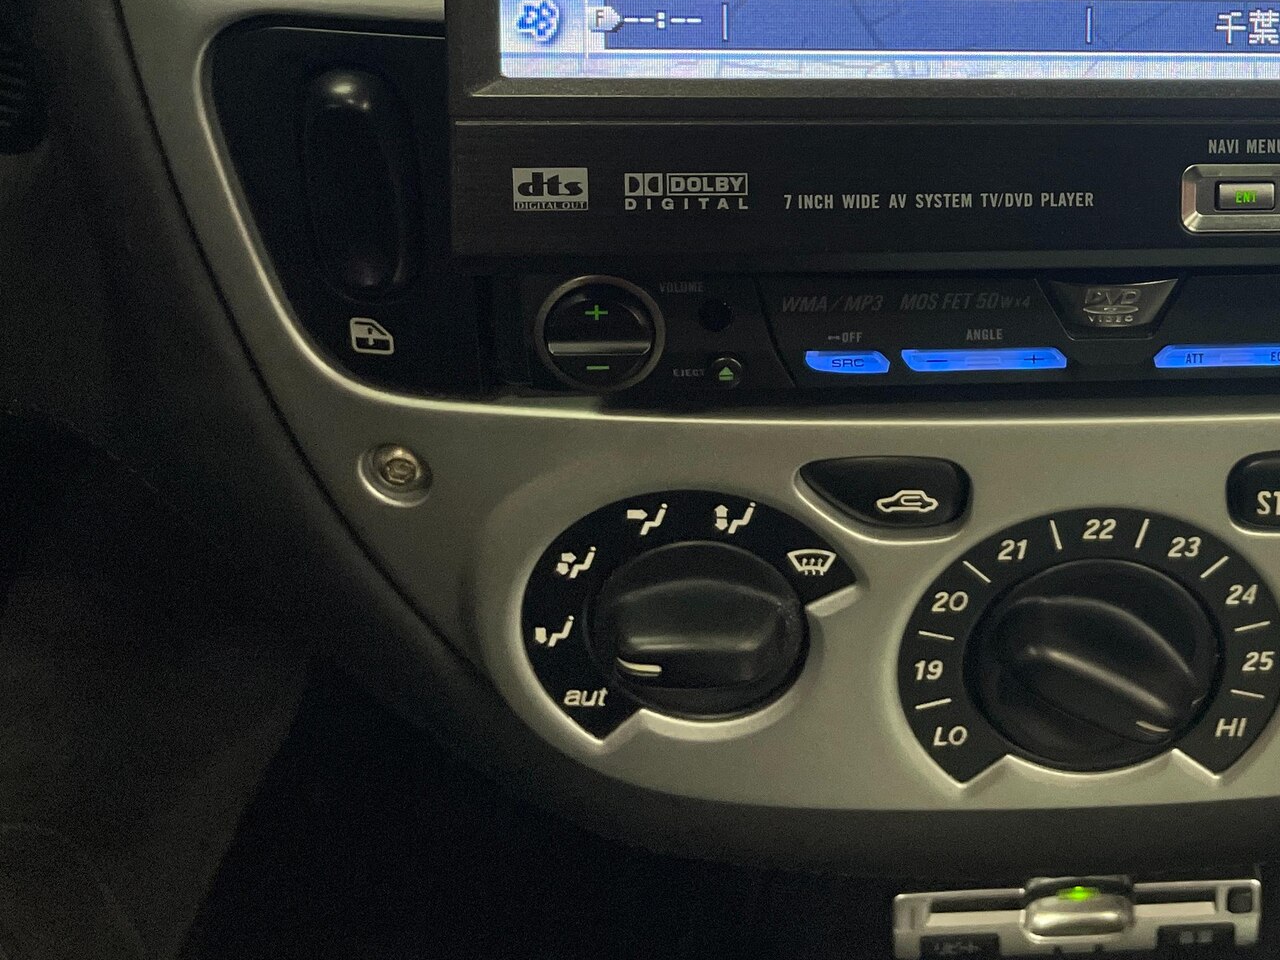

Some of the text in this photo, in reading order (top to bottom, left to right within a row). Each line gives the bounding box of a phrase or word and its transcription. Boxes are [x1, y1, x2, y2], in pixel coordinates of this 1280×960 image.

[1208, 139, 1239, 154] NAVI
[517, 171, 584, 197] dts
[670, 176, 744, 192] DOLBY
[517, 201, 586, 210] DIGITAL OUT
[624, 198, 749, 210] DIGITAL
[783, 192, 1094, 210] 7 INCH WIDE AV SYSTEM TV/DVD PLAYER
[660, 281, 704, 293] VOLUME
[1085, 288, 1142, 306] DVD
[841, 331, 864, 343] OFF
[966, 328, 1003, 340] ANGLE
[832, 359, 865, 368] SRC
[1185, 353, 1205, 364] ATT
[1082, 519, 1117, 539] 22
[998, 539, 1028, 560] 21
[1167, 537, 1201, 557] 23
[931, 591, 968, 612] 20
[1225, 584, 1258, 604] 24
[914, 660, 943, 680] 19
[1242, 652, 1275, 671] 25
[563, 687, 608, 708] aut
[933, 726, 967, 746] LO
[1215, 718, 1247, 737] HI
